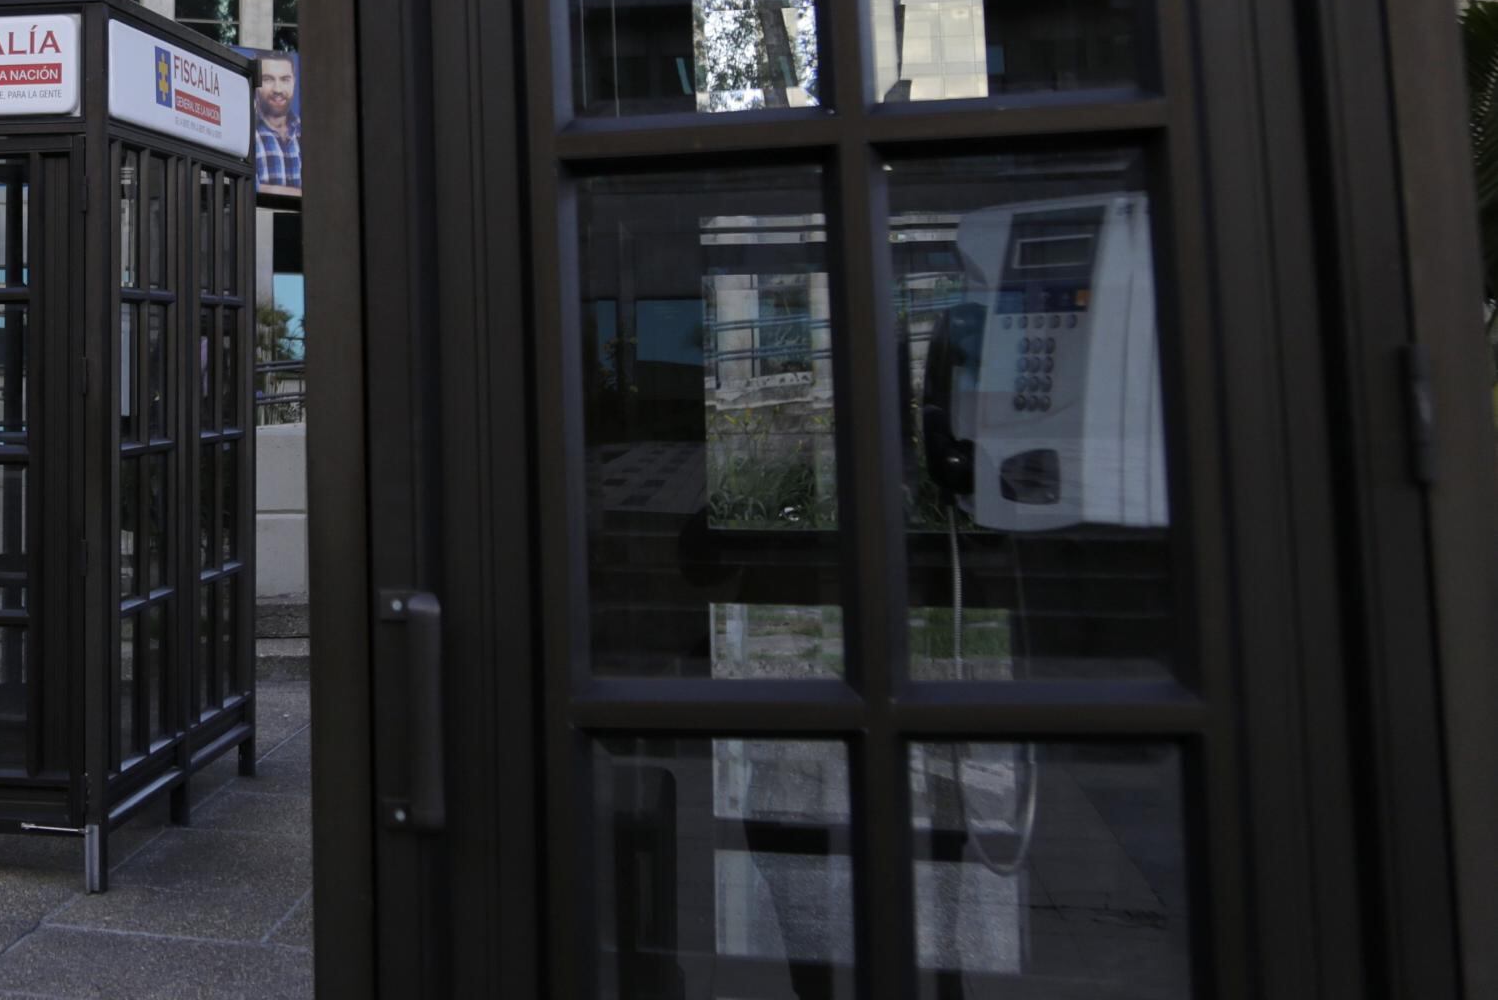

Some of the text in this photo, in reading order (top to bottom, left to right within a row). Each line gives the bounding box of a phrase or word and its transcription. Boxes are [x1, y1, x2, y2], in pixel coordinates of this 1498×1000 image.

[10, 65, 59, 80] NACIÓN
[174, 55, 220, 96] FISCALÍA
[8, 89, 27, 99] PARA
[28, 89, 38, 99] LA
[39, 88, 63, 99] GENTE
